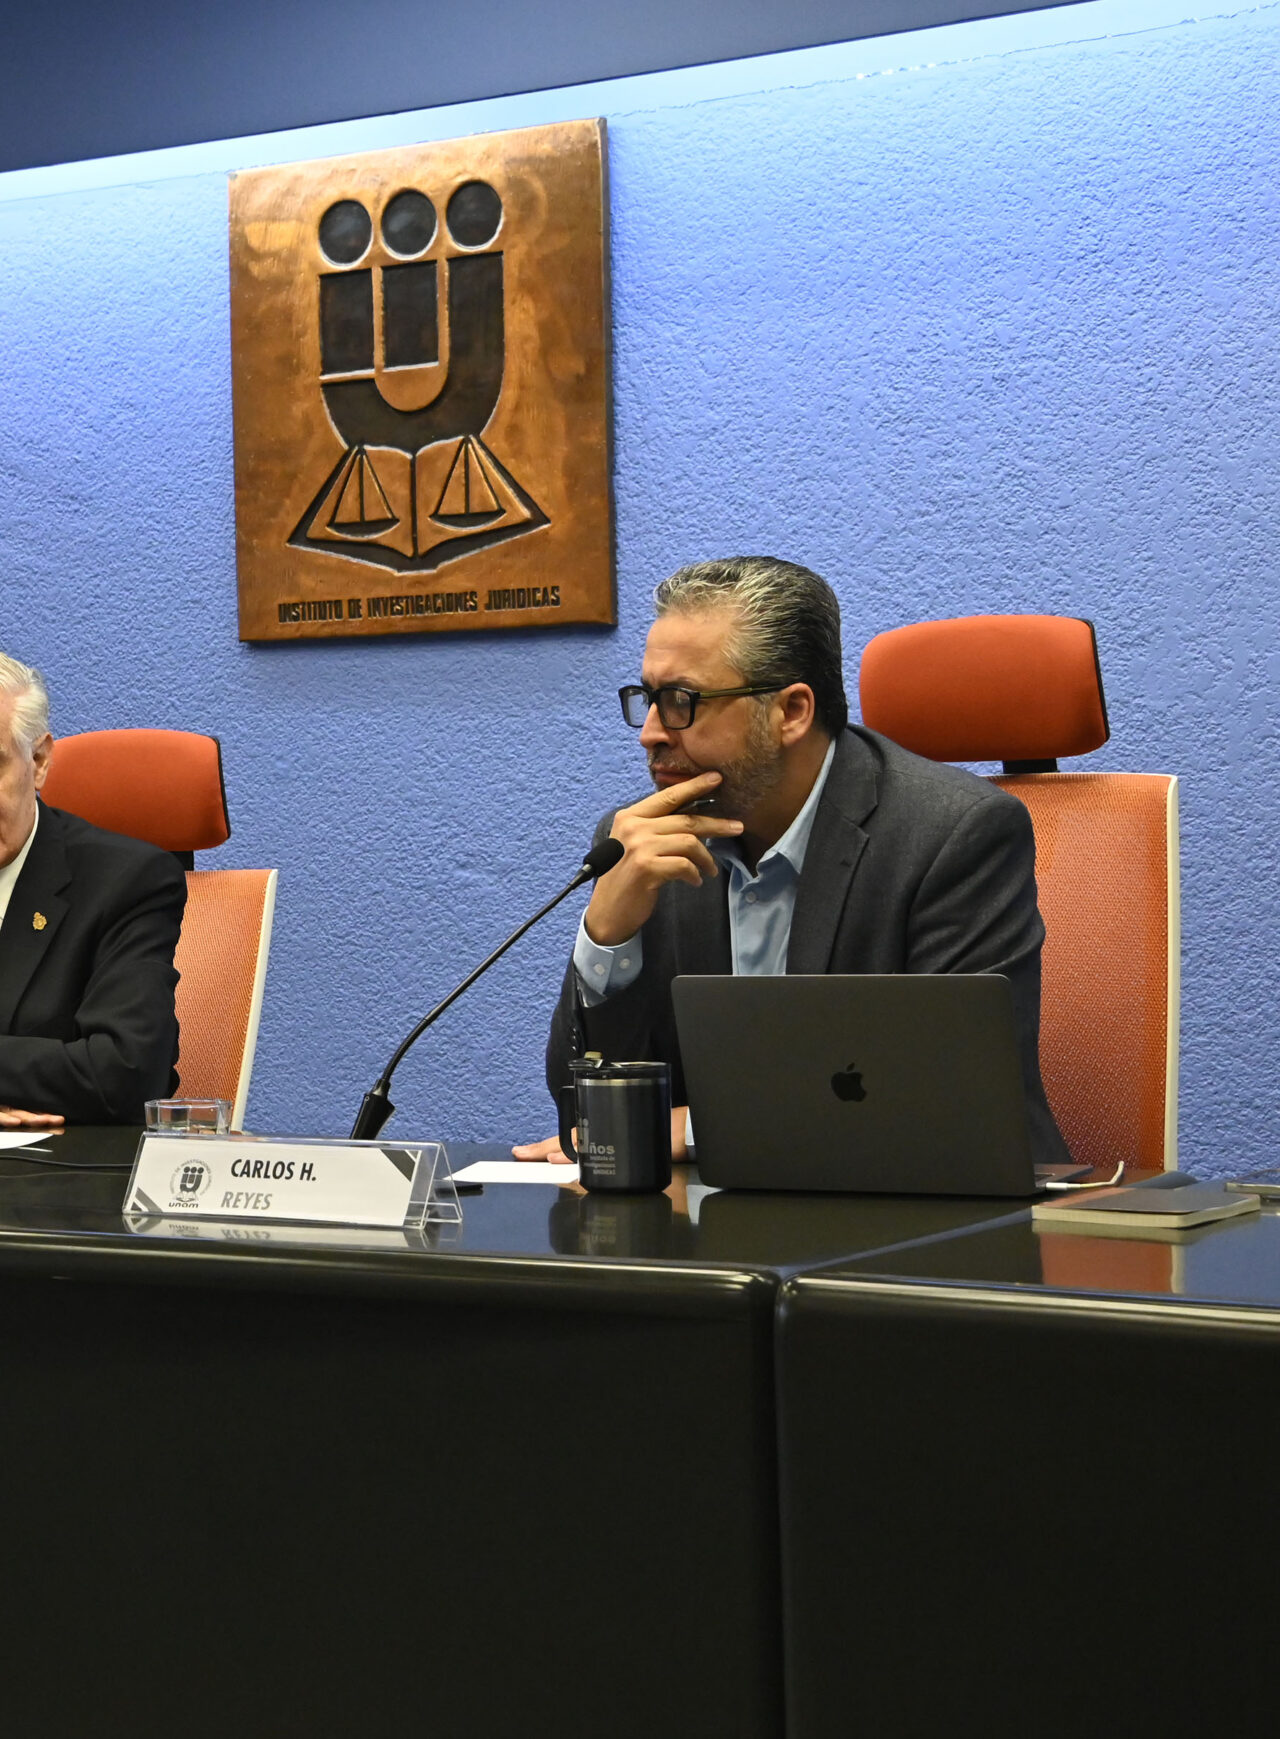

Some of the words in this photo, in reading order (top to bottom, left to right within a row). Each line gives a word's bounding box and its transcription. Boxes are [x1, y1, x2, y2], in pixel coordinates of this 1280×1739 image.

[278, 599, 343, 623] INSTITUTO
[348, 598, 362, 620] DE
[367, 591, 478, 619] INVESTIGACIONES
[484, 586, 560, 612] JURIDICAS
[231, 1158, 295, 1181] CARLOS
[299, 1162, 317, 1182] H.
[221, 1190, 273, 1211] REYES
